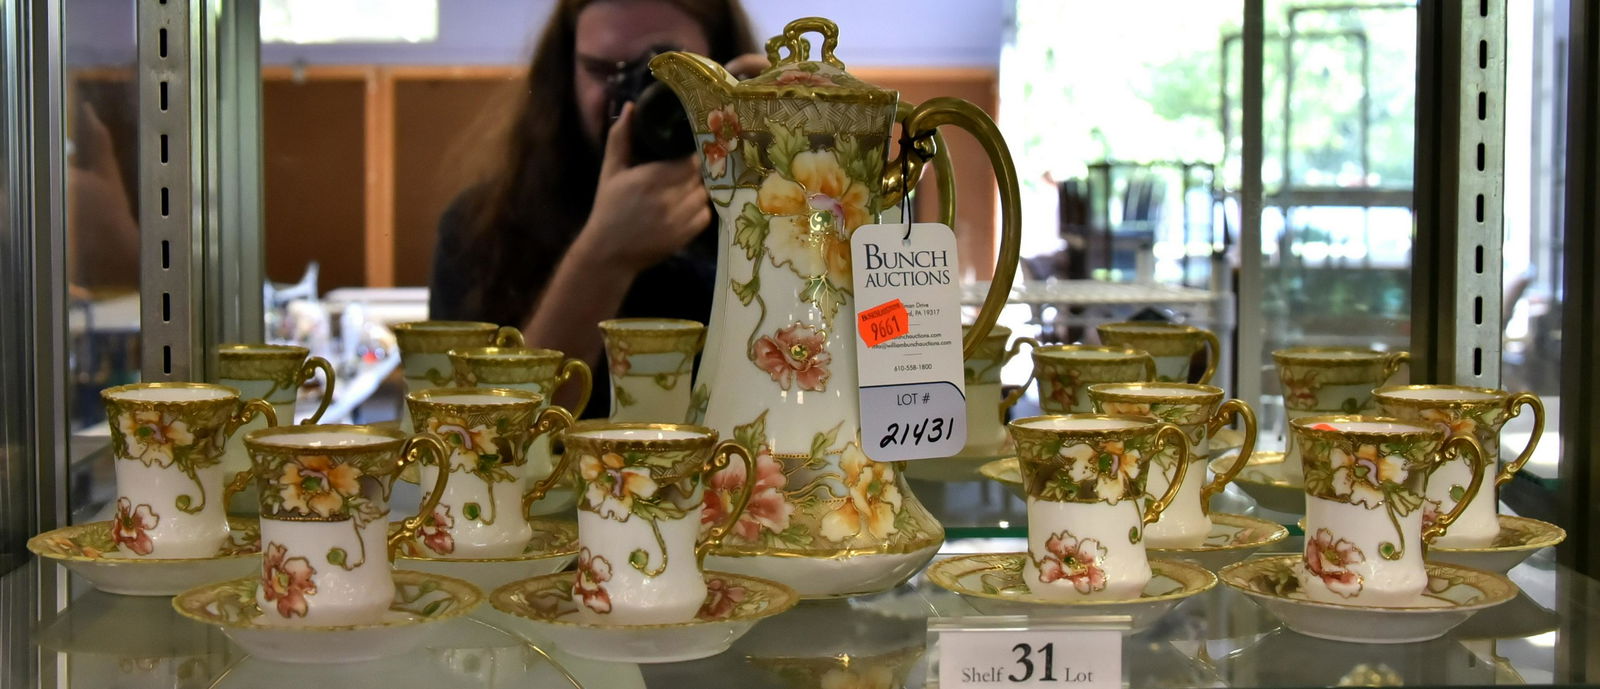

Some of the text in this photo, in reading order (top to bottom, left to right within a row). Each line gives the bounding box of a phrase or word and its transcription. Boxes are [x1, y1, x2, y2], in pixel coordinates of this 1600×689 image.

[865, 269, 951, 288] AUCTIONS
[894, 364, 933, 372] 610-558-1800
[897, 392, 930, 406] LOT #
[879, 417, 954, 448] 21431
[961, 642, 1093, 683] Shelf 31 Lot
